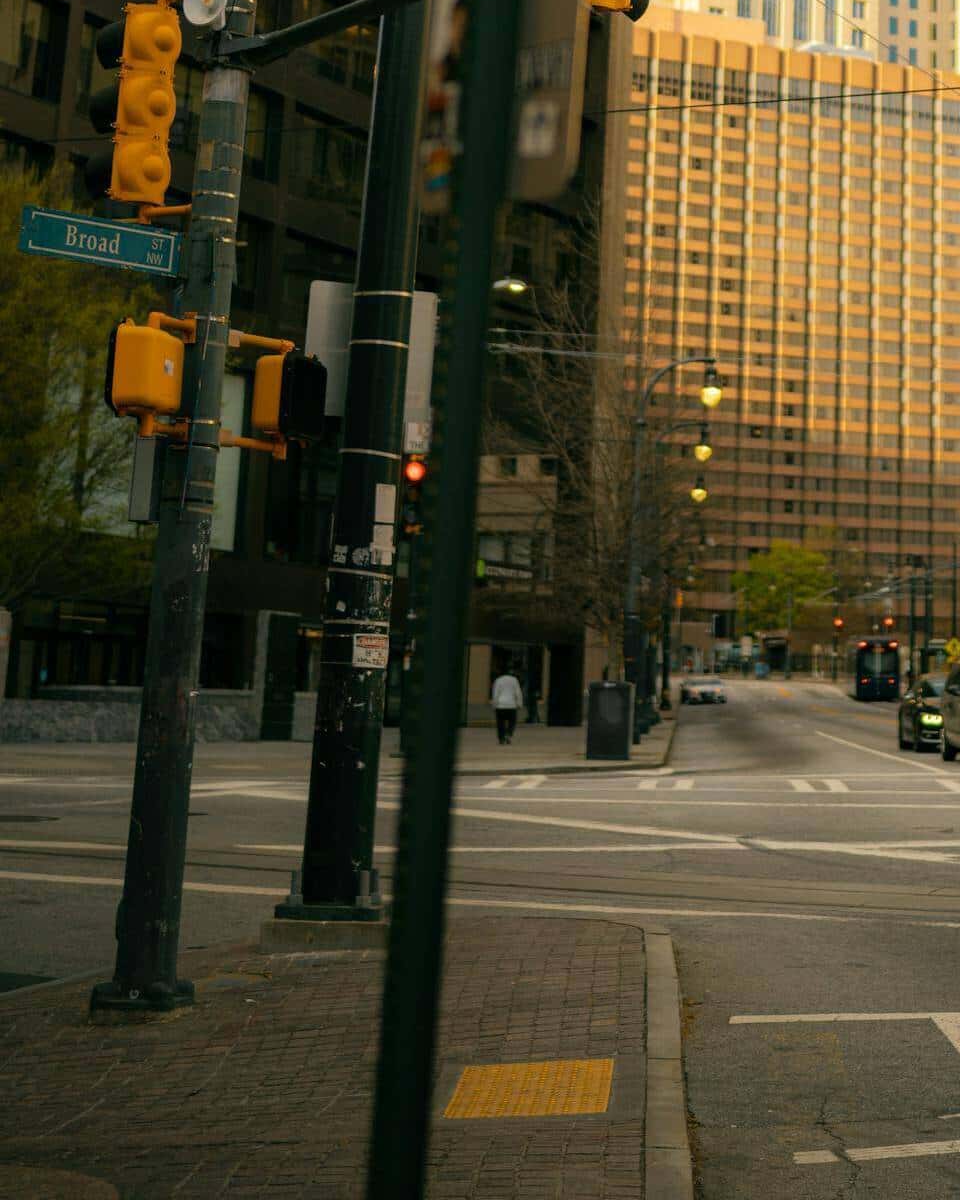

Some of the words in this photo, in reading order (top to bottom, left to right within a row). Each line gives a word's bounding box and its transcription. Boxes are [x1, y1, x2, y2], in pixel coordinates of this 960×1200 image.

[65, 224, 120, 255] Broad
[152, 238, 163, 250] ST
[146, 254, 163, 265] NW
